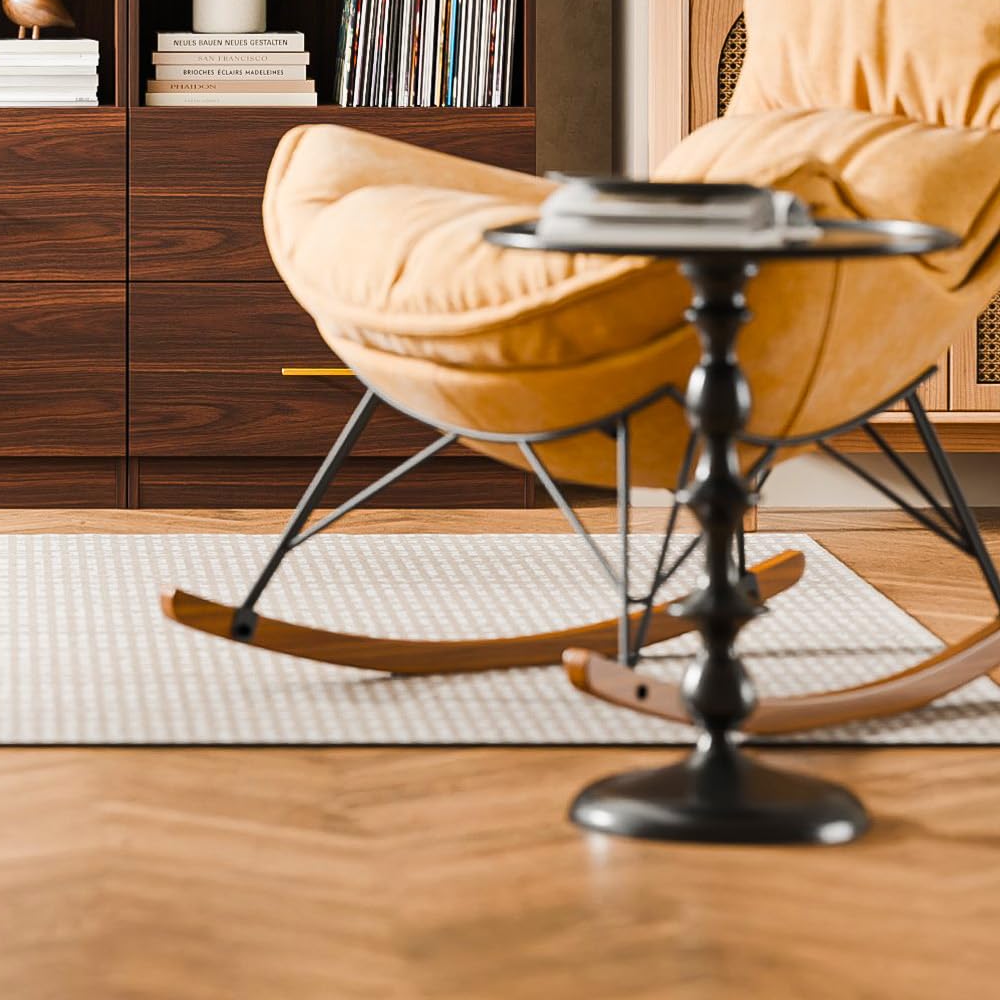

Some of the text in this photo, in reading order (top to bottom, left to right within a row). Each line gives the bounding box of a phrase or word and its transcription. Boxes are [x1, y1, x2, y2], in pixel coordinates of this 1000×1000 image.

[173, 39, 288, 47] NEUES BAUEN NEUES GESTALTEN
